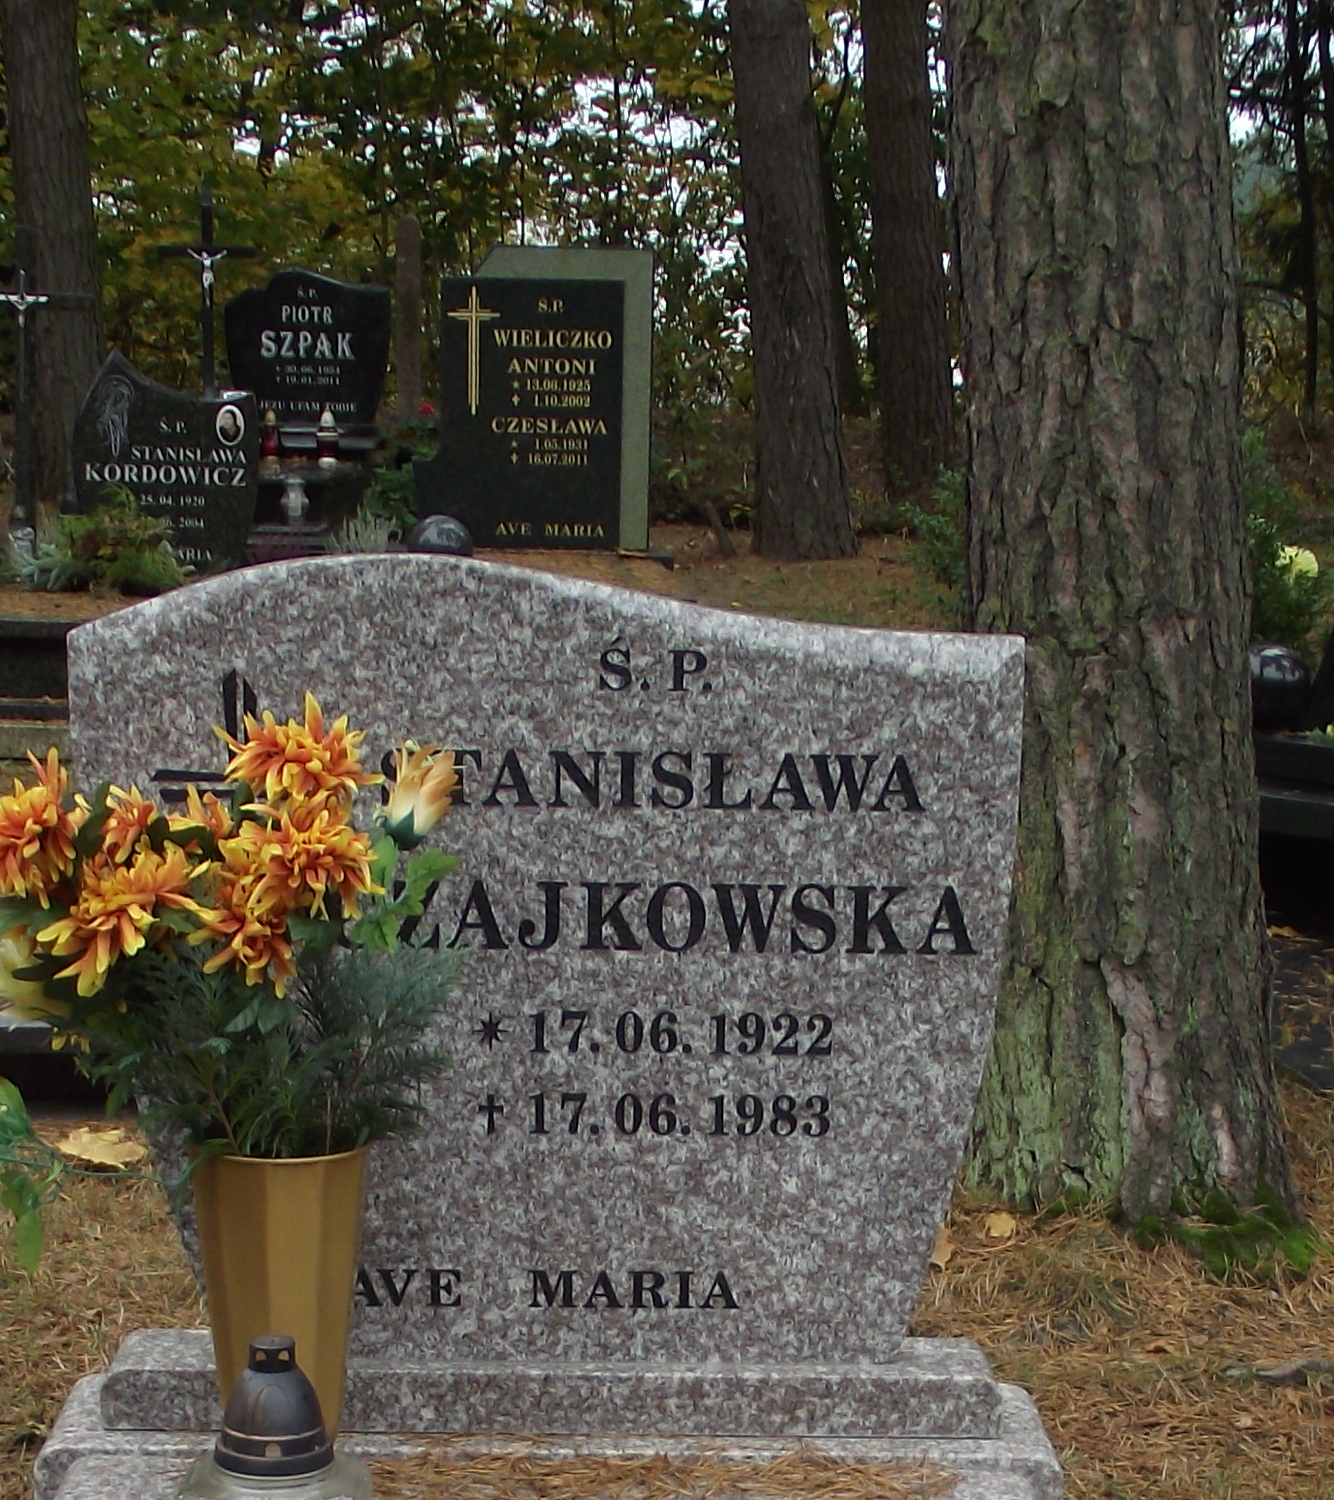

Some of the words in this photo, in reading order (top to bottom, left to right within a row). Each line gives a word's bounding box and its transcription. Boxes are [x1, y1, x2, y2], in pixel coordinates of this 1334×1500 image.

[281, 304, 334, 326] PIOTR
[260, 329, 356, 361] SZPAK
[492, 329, 613, 350] WIELICZKO
[507, 357, 596, 375] ANTONI
[84, 462, 247, 487] KORDOWICZ
[495, 522, 532, 537] AVE
[544, 523, 605, 538] MARIA
[338, 878, 977, 957] ZAJKOWSKA
[354, 1267, 462, 1309] AVE
[528, 1269, 741, 1310] MARIA
